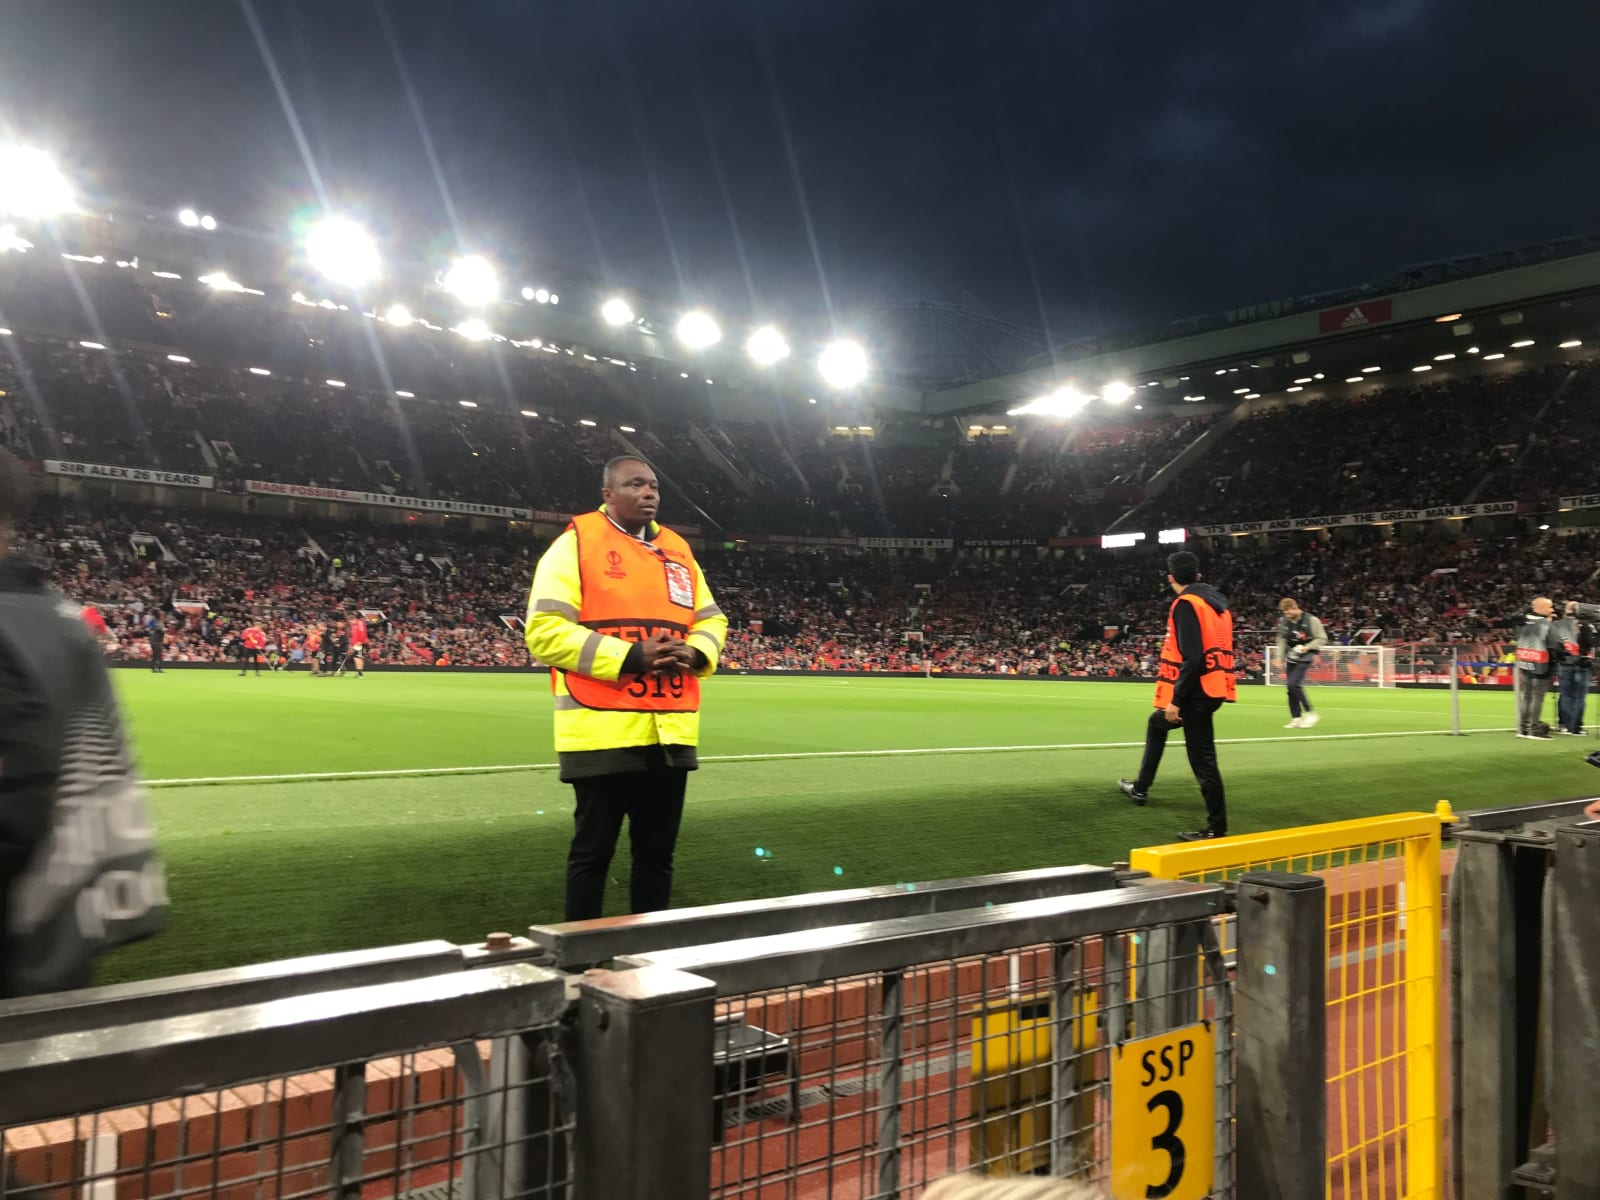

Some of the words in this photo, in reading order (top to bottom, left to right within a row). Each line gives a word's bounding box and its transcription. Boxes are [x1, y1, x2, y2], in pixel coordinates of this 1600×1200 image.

[59, 462, 86, 474] SIR
[90, 464, 129, 478] ALEX
[133, 469, 150, 480] 26
[155, 472, 201, 485] YEARS
[251, 481, 288, 492] MADE
[1230, 522, 1264, 532] GLORY
[1269, 519, 1291, 529] AND
[1353, 513, 1375, 523] THE
[1380, 511, 1420, 521] GREAT
[1426, 507, 1454, 518] MAN
[1460, 505, 1477, 515] HE
[1483, 502, 1515, 514] SAID
[627, 671, 684, 698] 319
[1141, 1039, 1194, 1087] SSP
[1145, 1089, 1187, 1200] 3
